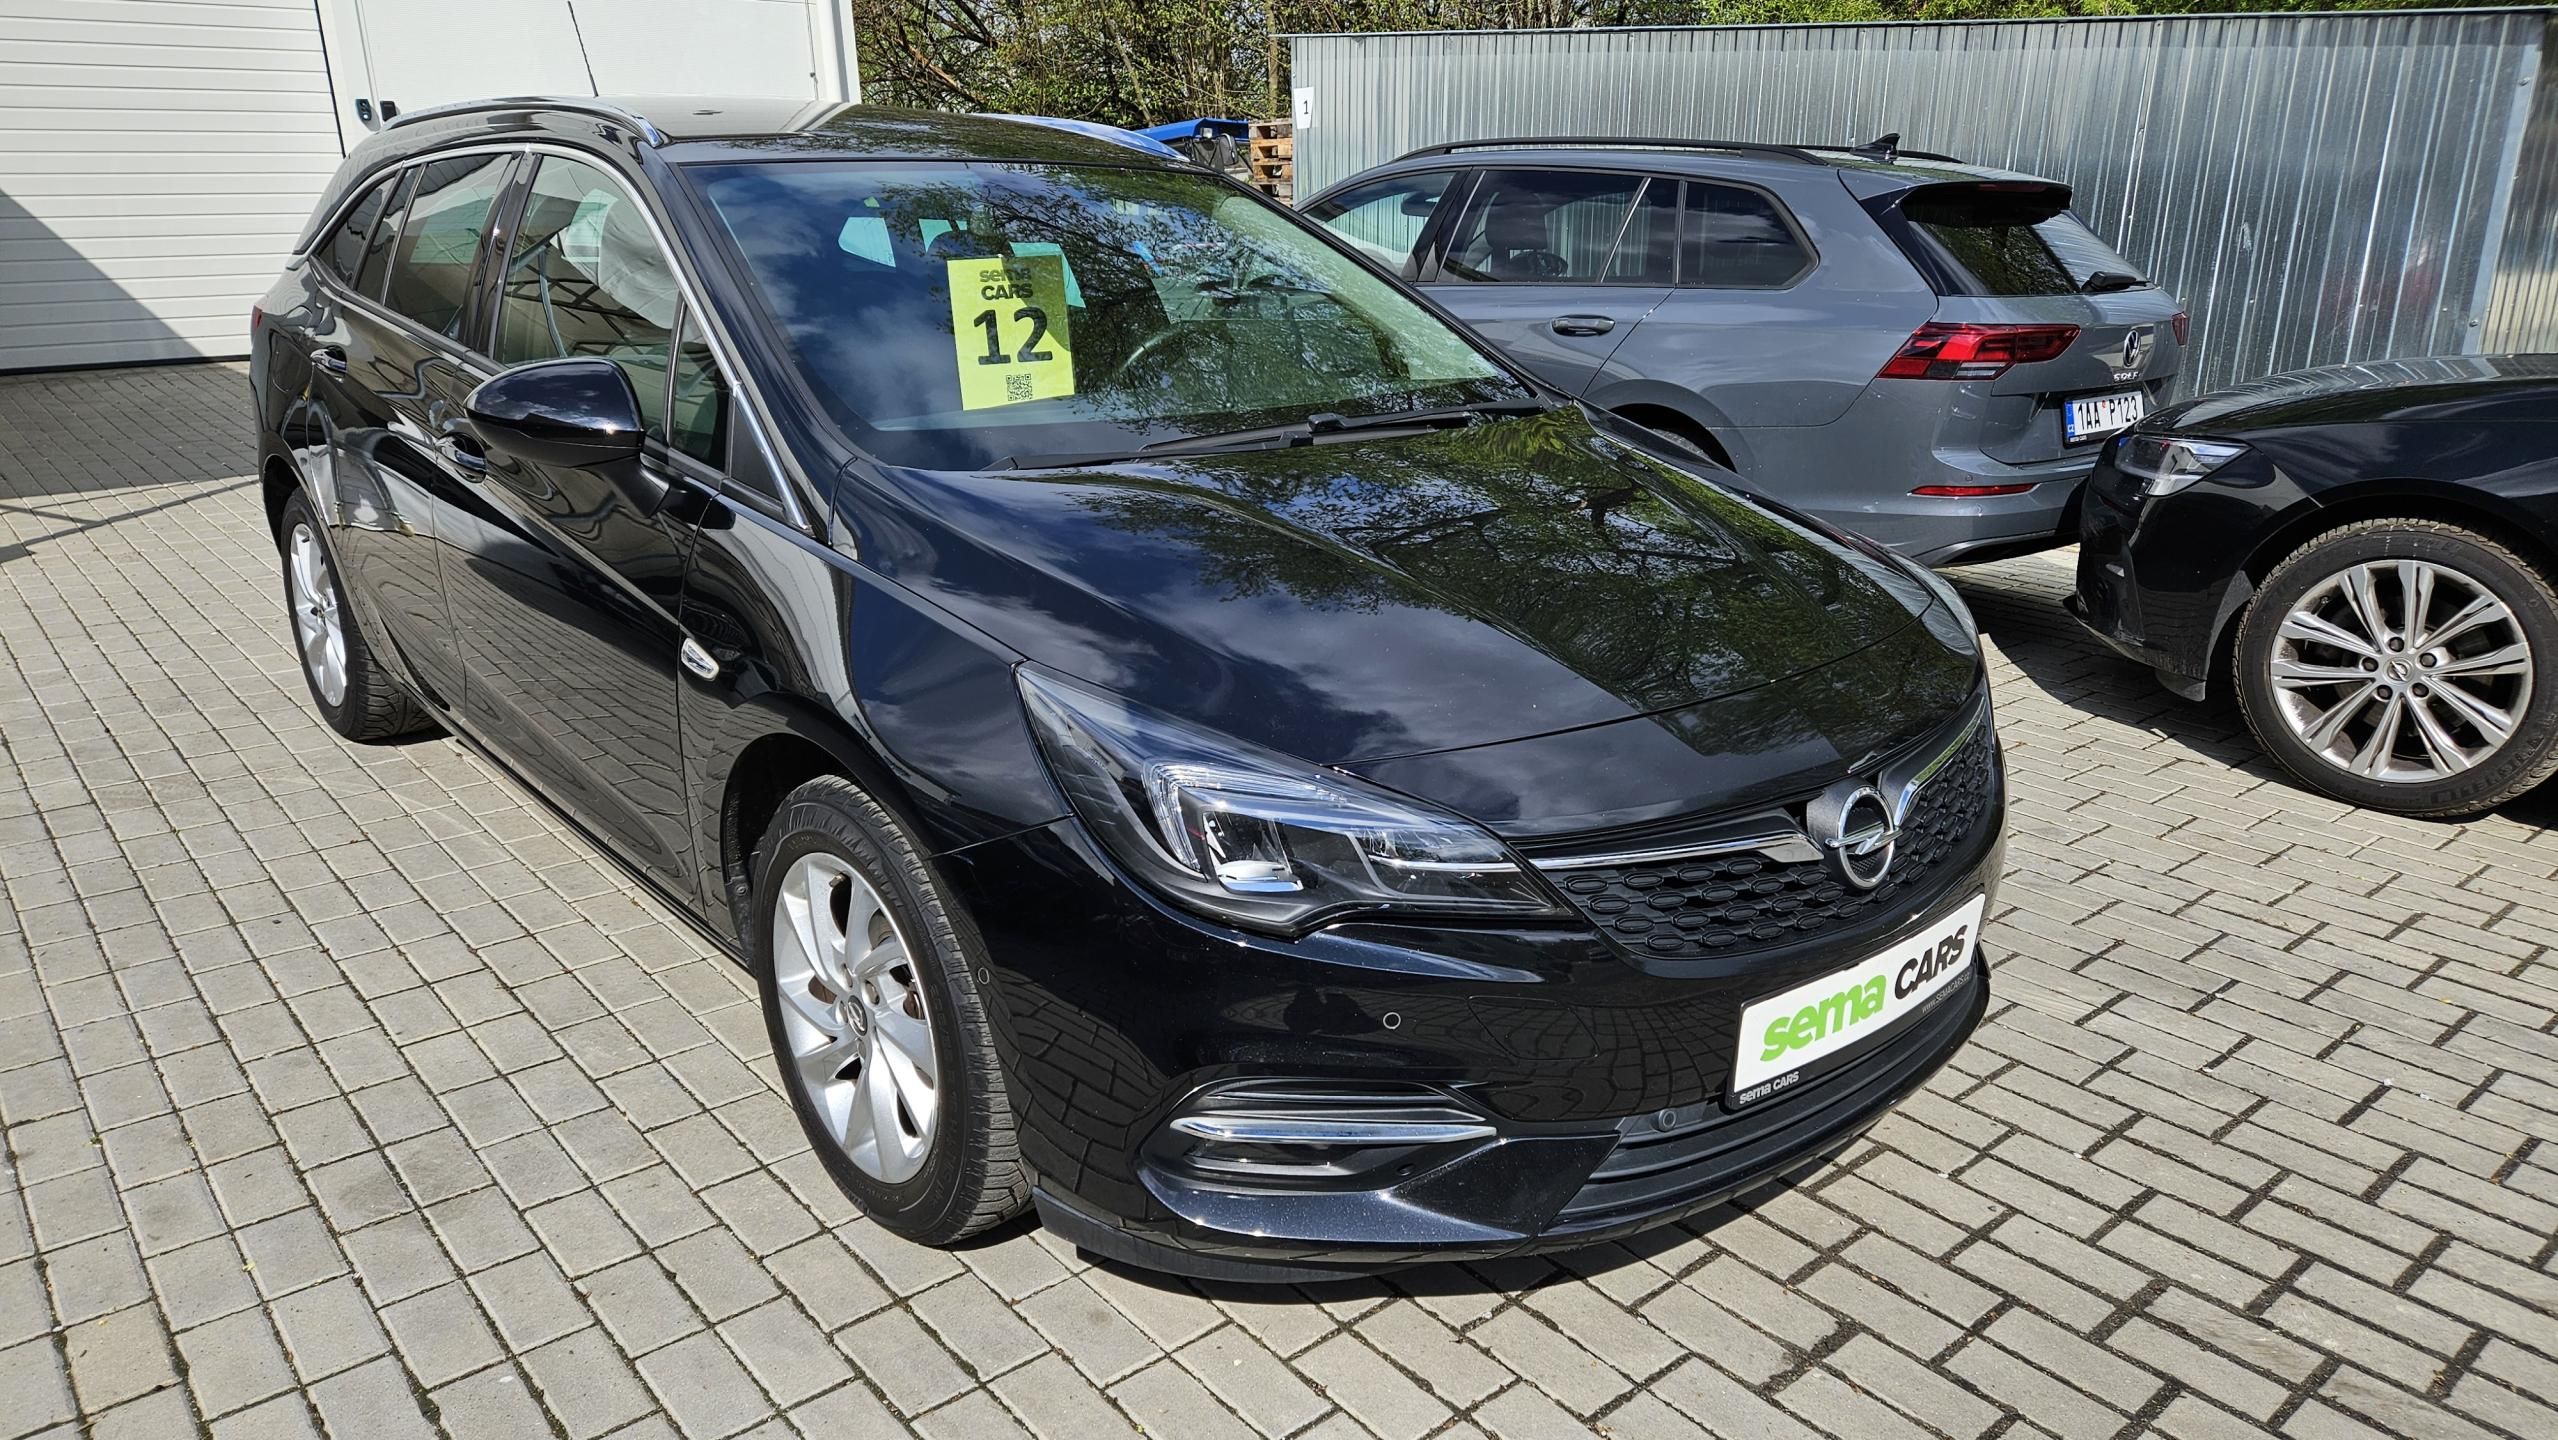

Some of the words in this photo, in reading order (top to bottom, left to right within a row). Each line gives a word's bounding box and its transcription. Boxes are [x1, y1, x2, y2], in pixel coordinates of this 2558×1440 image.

[1303, 101, 1309, 114] 1
[979, 268, 1032, 282] sema
[980, 284, 1033, 300] CARS
[973, 306, 1053, 366] 12
[2078, 402, 2100, 431] 1AA
[2109, 396, 2137, 425] P123
[1759, 974, 1888, 1062] sema
[1893, 924, 1968, 1001] CARS
[1739, 1082, 1772, 1105] sema
[1772, 1071, 1800, 1090] CARS
